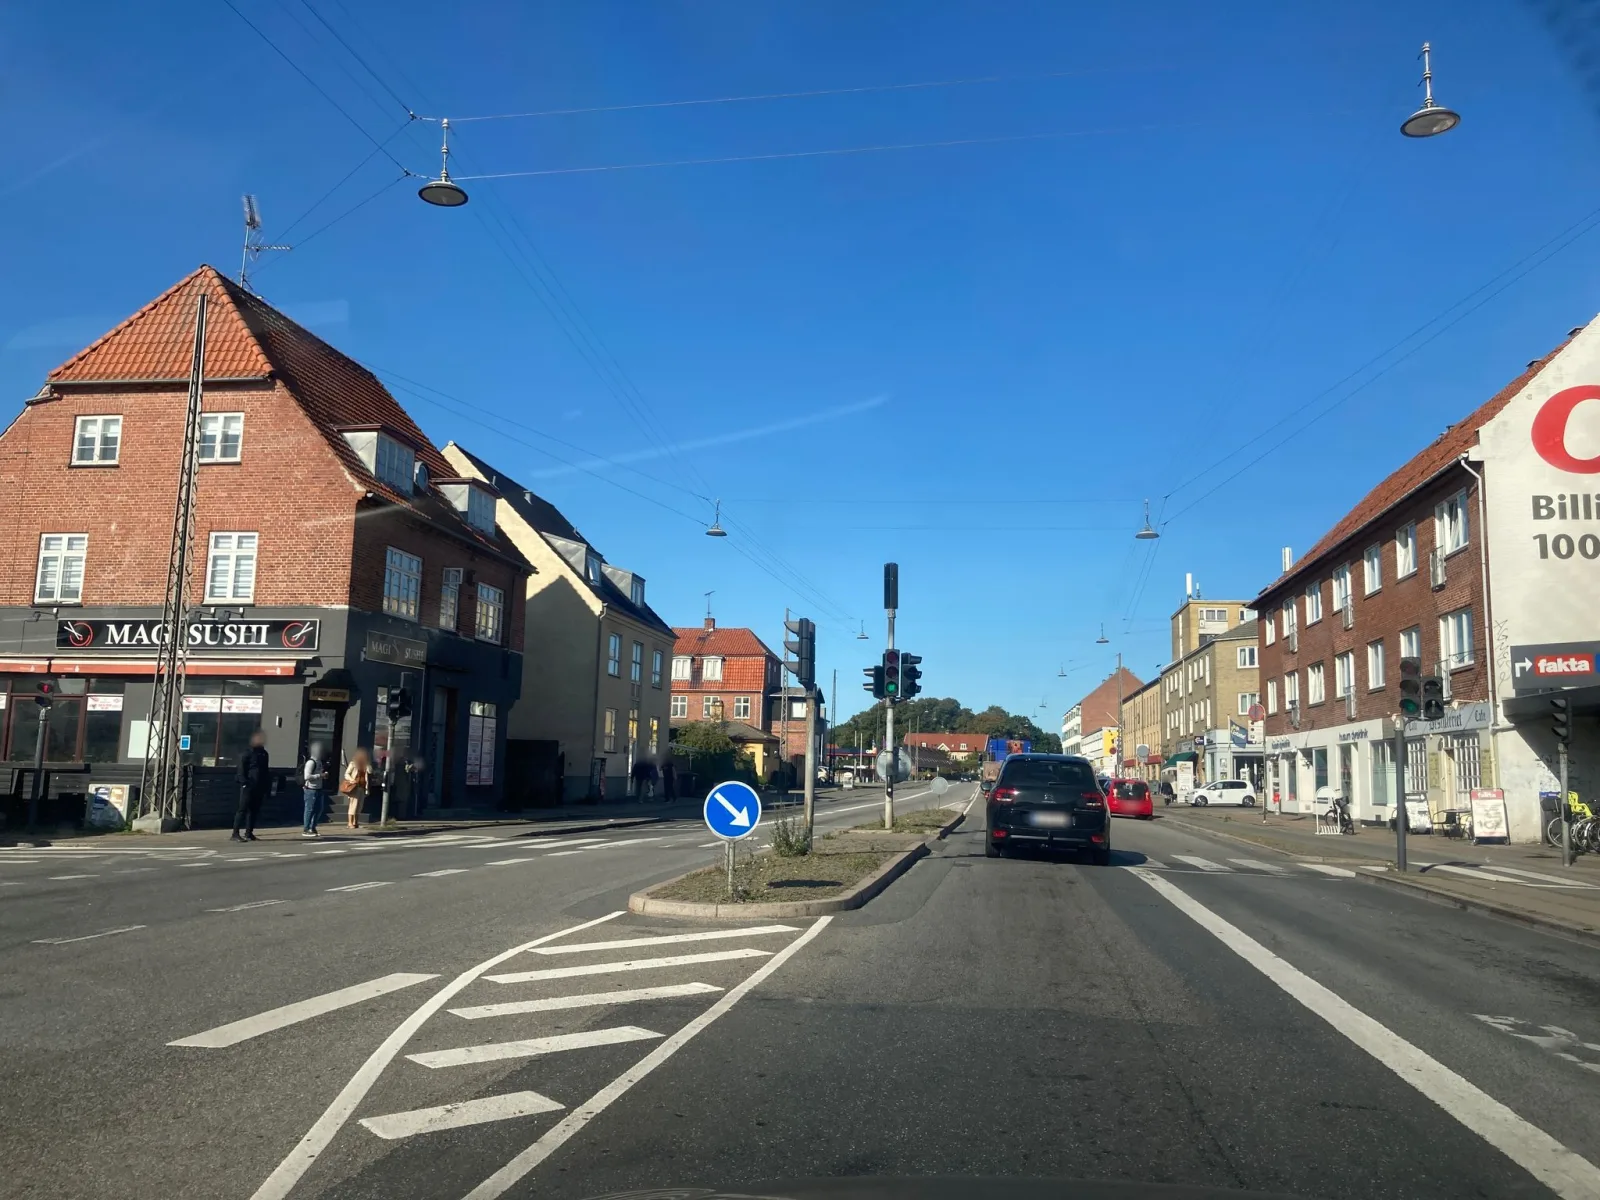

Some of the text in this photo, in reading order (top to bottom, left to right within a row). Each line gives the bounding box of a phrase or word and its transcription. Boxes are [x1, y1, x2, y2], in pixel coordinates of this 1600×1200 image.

[1532, 533, 1600, 560] 100
[105, 624, 270, 646] MAG SUSHI
[1537, 657, 1590, 674] fakta
